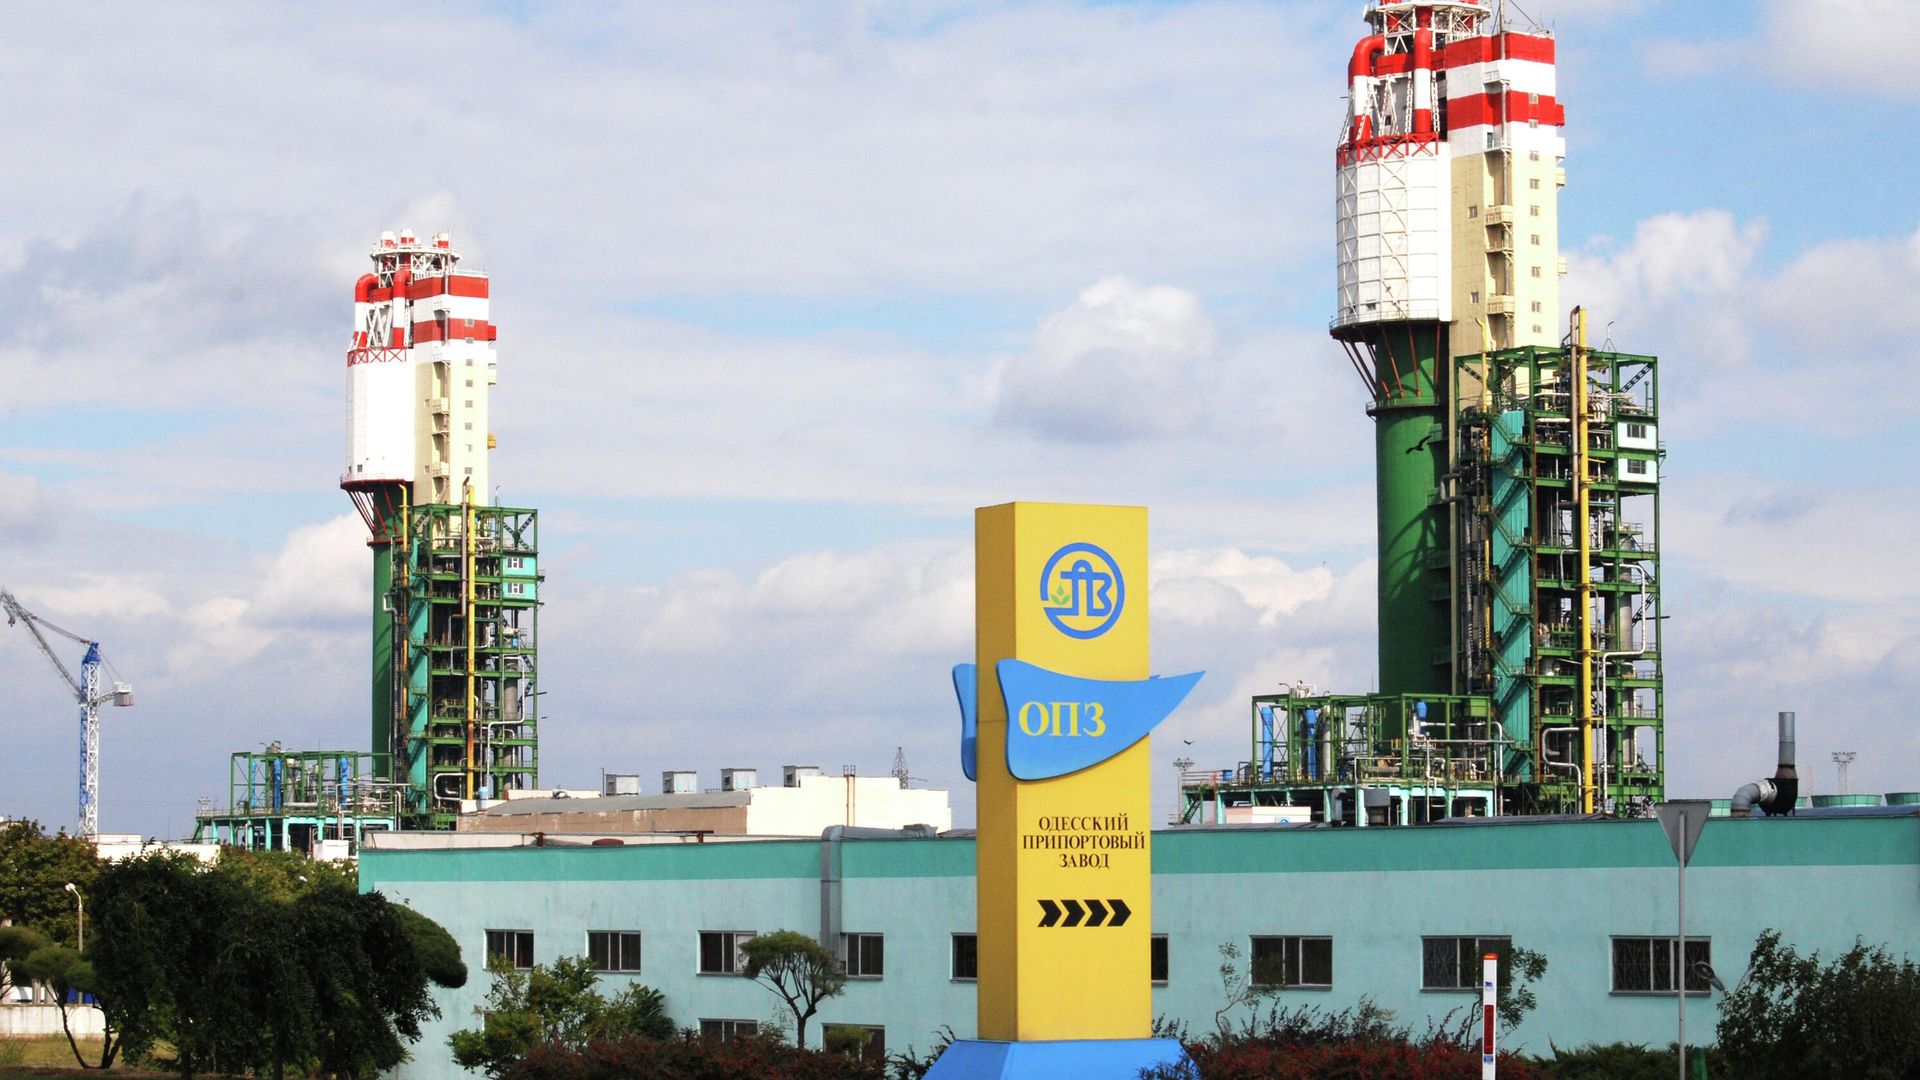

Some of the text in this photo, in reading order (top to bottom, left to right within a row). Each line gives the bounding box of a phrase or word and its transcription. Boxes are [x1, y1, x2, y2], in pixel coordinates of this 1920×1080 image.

[1018, 701, 1107, 737] ОПЗ
[1038, 813, 1129, 832] ОДЕССКИЙ
[1023, 831, 1145, 849] ПРИПОРТОВЫЙ
[1059, 853, 1110, 869] ЗАВОД
